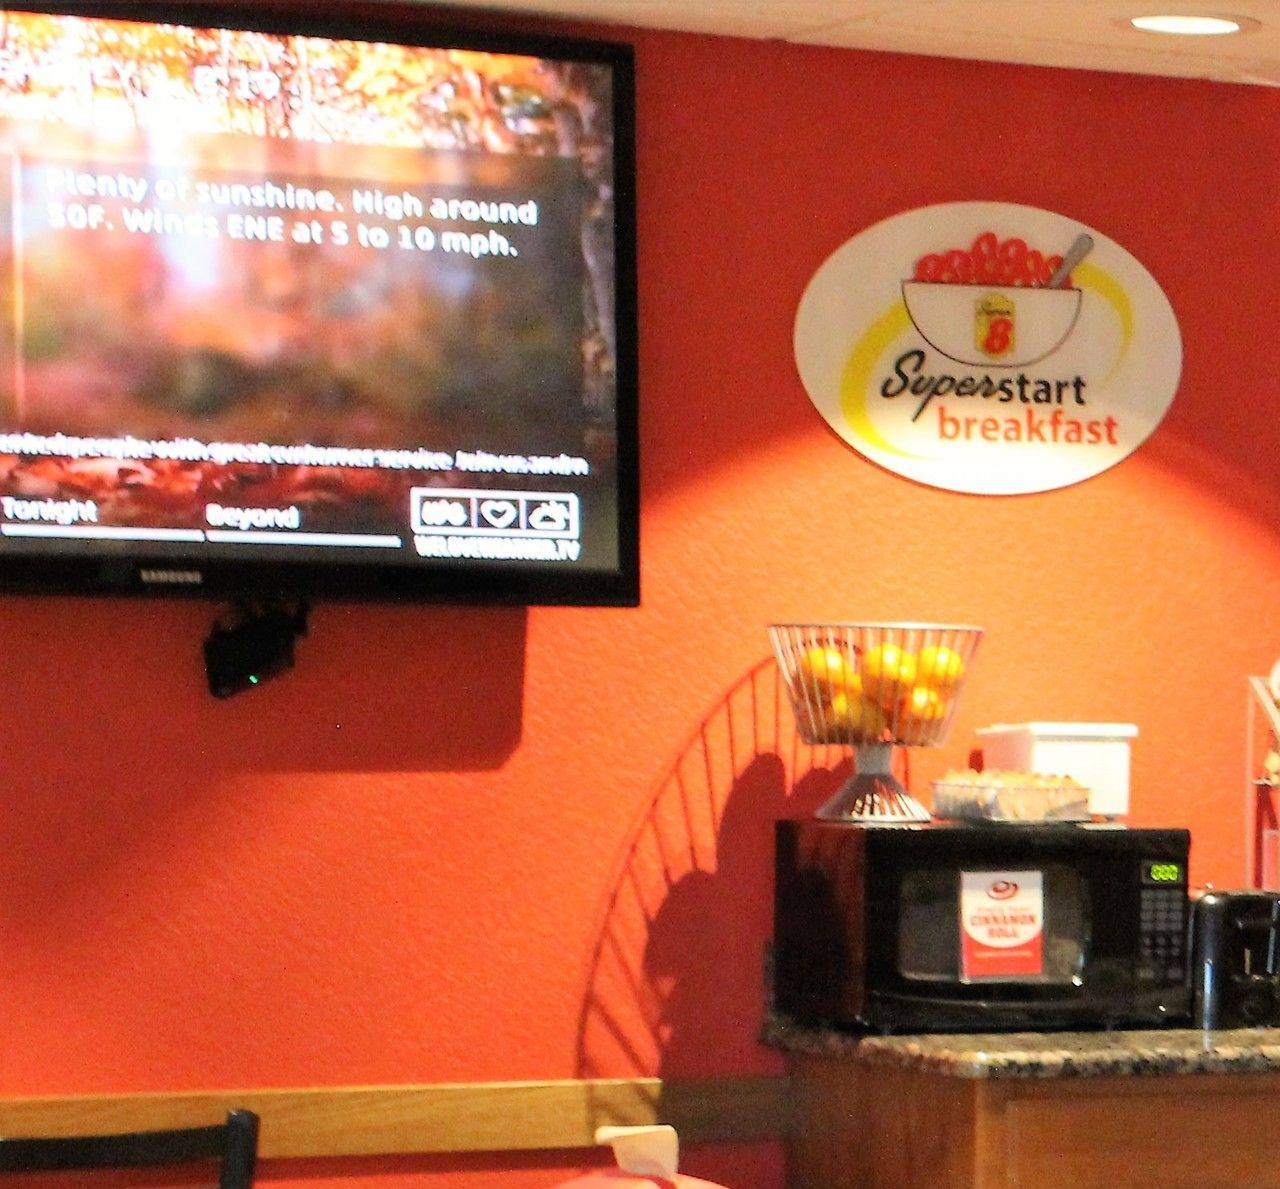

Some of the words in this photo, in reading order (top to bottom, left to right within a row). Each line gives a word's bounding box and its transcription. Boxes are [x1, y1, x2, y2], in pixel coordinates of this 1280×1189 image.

[48, 168, 149, 203] Plenty
[155, 176, 190, 202] of
[195, 181, 344, 213] sunshine.
[353, 189, 423, 220] High
[429, 198, 538, 226] around
[121, 206, 220, 238] Winds
[227, 213, 284, 241] ENE
[291, 220, 323, 245] at
[330, 220, 349, 246] 5
[357, 223, 389, 248] to
[398, 224, 435, 251] 10
[441, 230, 519, 259] mph.
[937, 406, 1119, 446] breakfast
[2, 497, 99, 525] Tonight
[205, 503, 301, 531] Beyond
